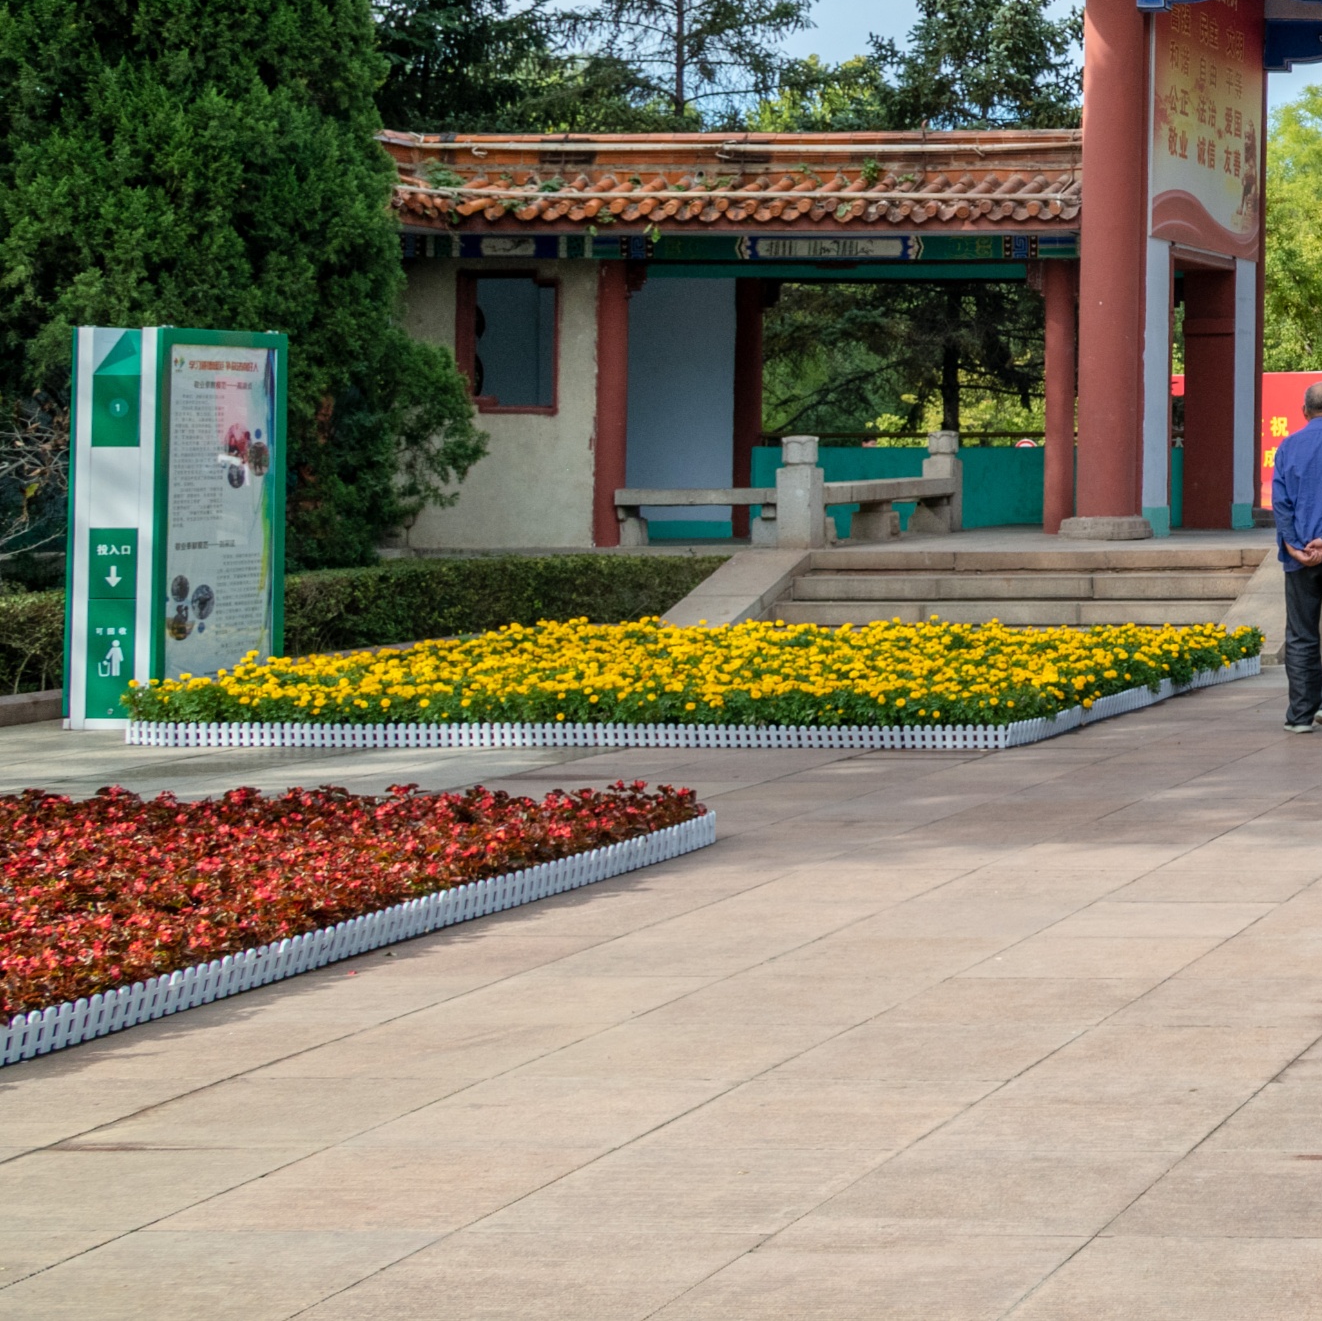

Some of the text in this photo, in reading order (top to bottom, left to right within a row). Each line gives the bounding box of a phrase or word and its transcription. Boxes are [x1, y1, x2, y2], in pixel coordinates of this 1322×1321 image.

[1199, 11, 1219, 49] 民主
[1226, 28, 1245, 62] 文明
[1169, 41, 1243, 99] 和谐 自由 平等
[1168, 85, 1243, 140] 公正 法治 爱国
[1168, 126, 1242, 178] 敬业 诚信 友善
[96, 543, 132, 556] 投入口
[95, 627, 128, 636] 可回收
